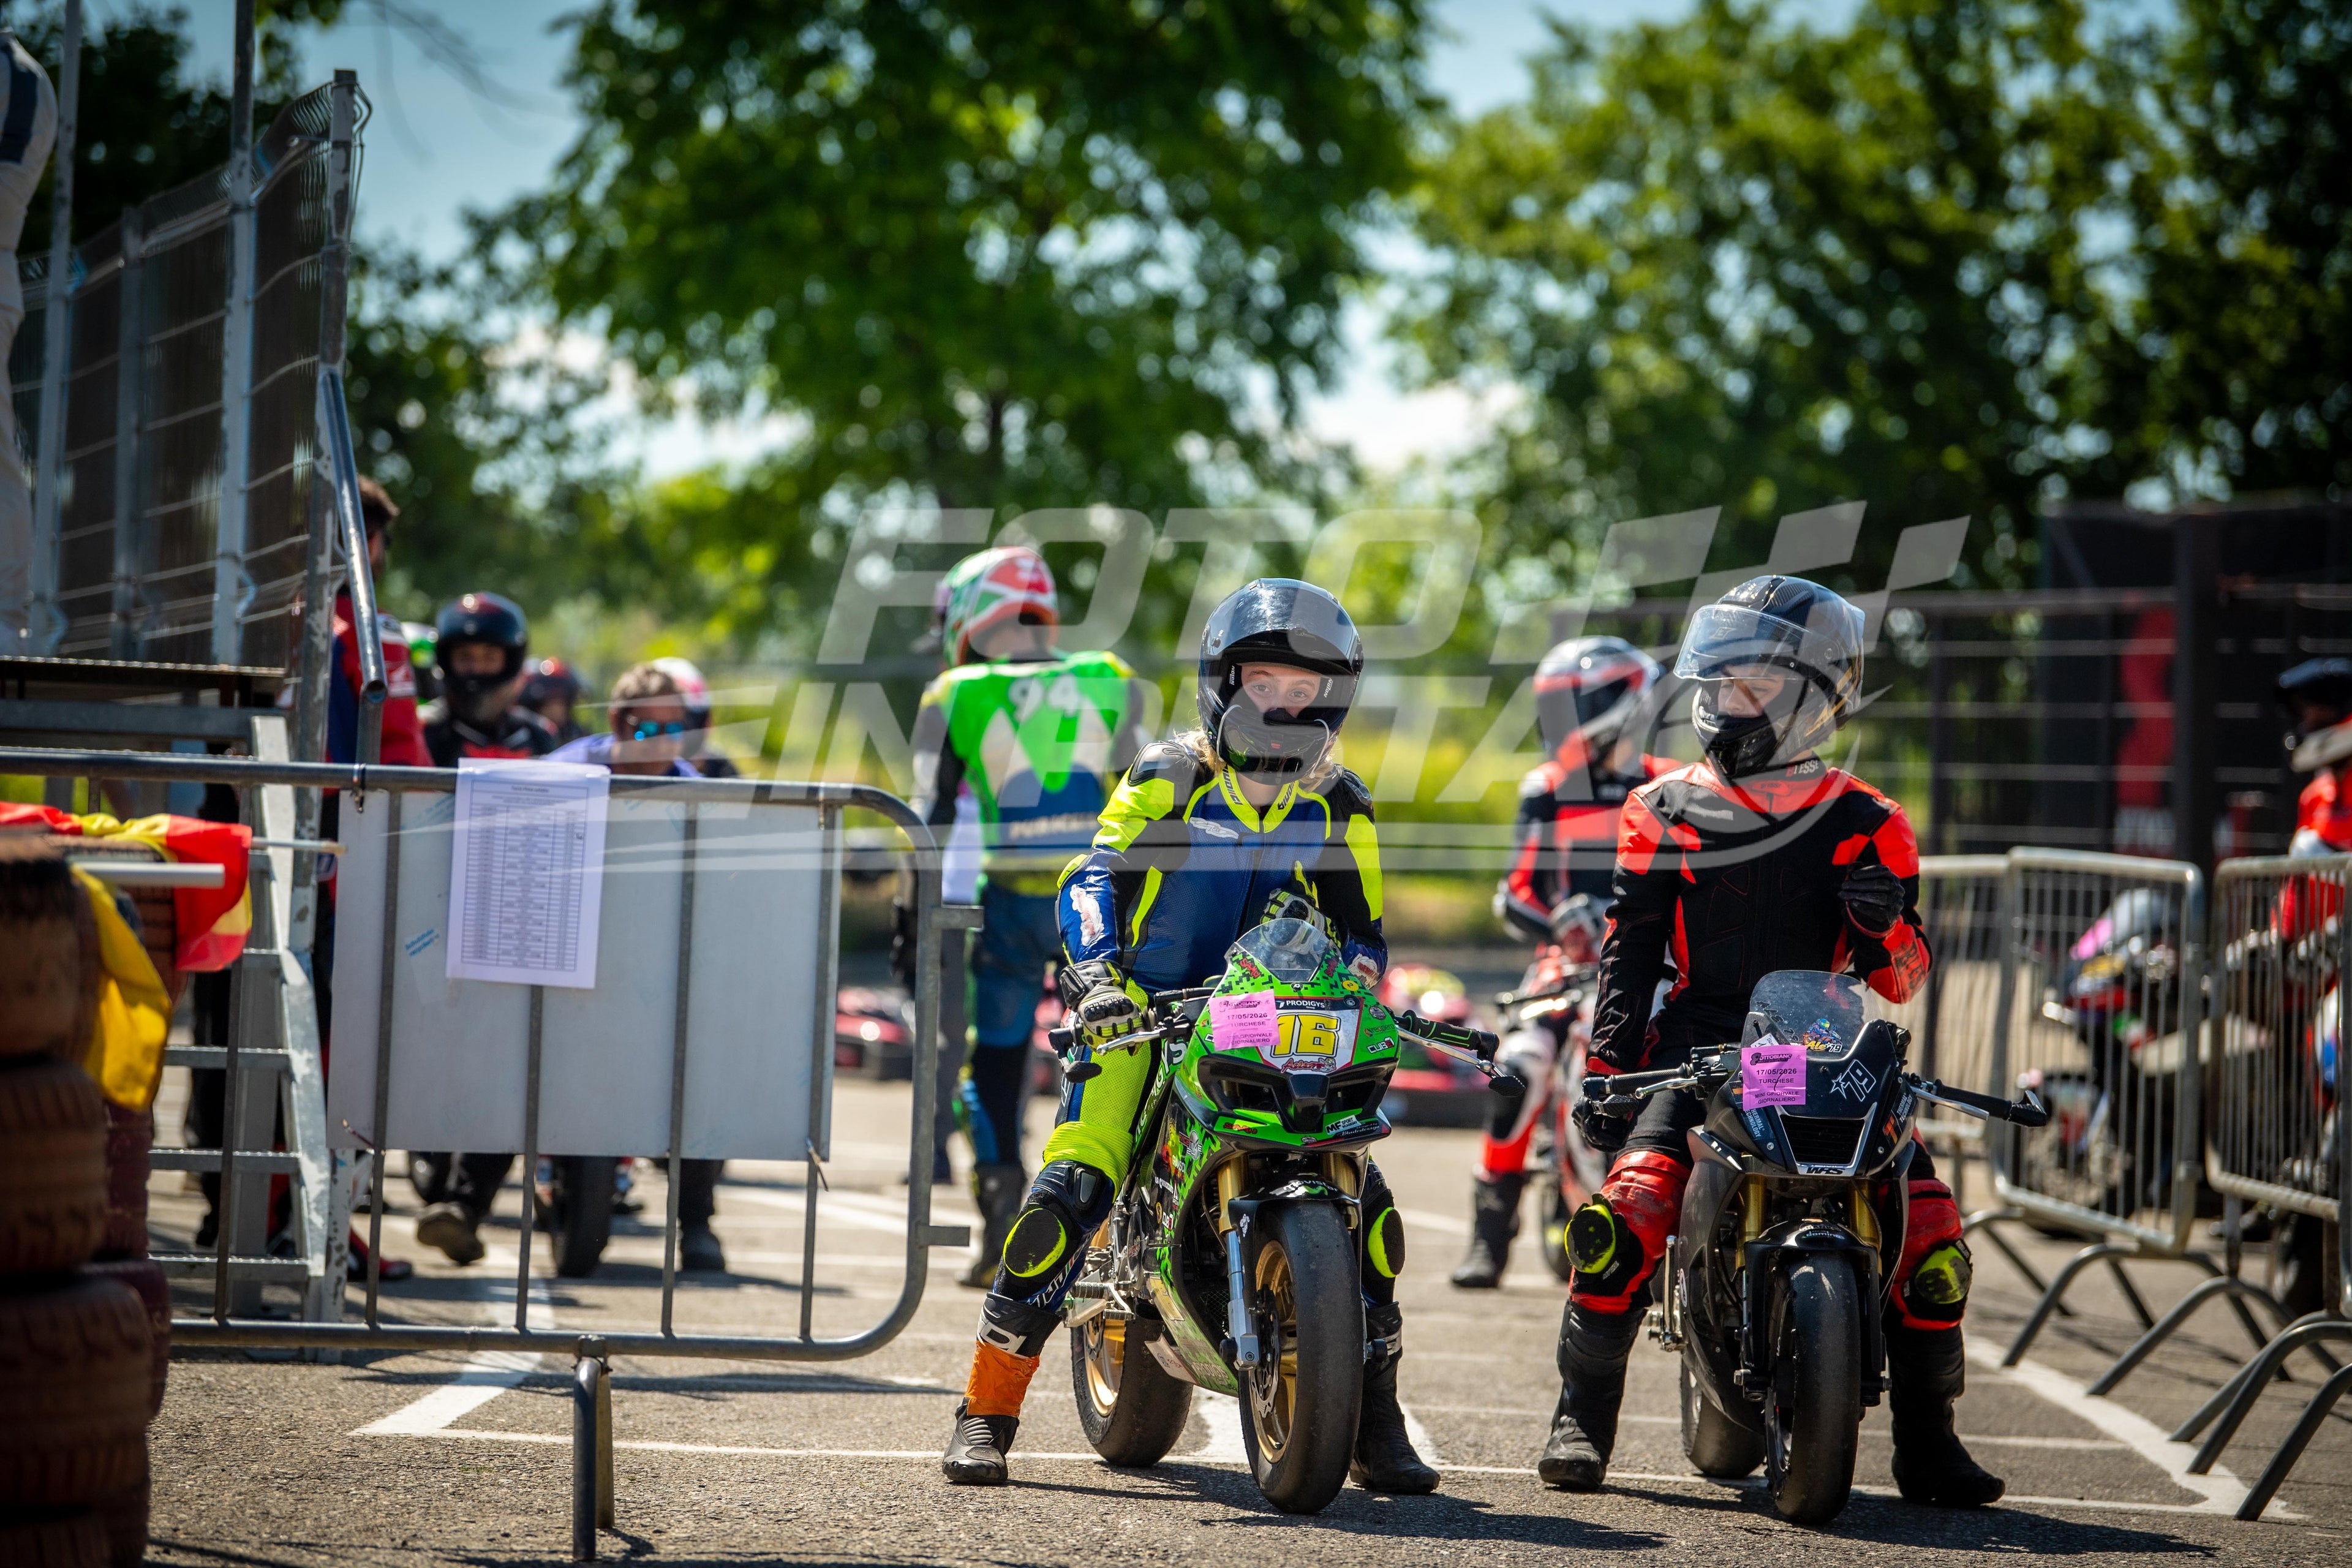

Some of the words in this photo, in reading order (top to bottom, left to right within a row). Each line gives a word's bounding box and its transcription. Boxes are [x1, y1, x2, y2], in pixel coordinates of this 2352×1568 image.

[1324, 678, 1333, 698] NOLAN
[1271, 1012, 1340, 1058] 16
[1829, 1044, 1843, 1053] 79
[1326, 1121, 1341, 1134] MF
[1745, 1110, 1762, 1137] ECHNOLOGY
[1751, 1109, 1763, 1131] HERMAL
